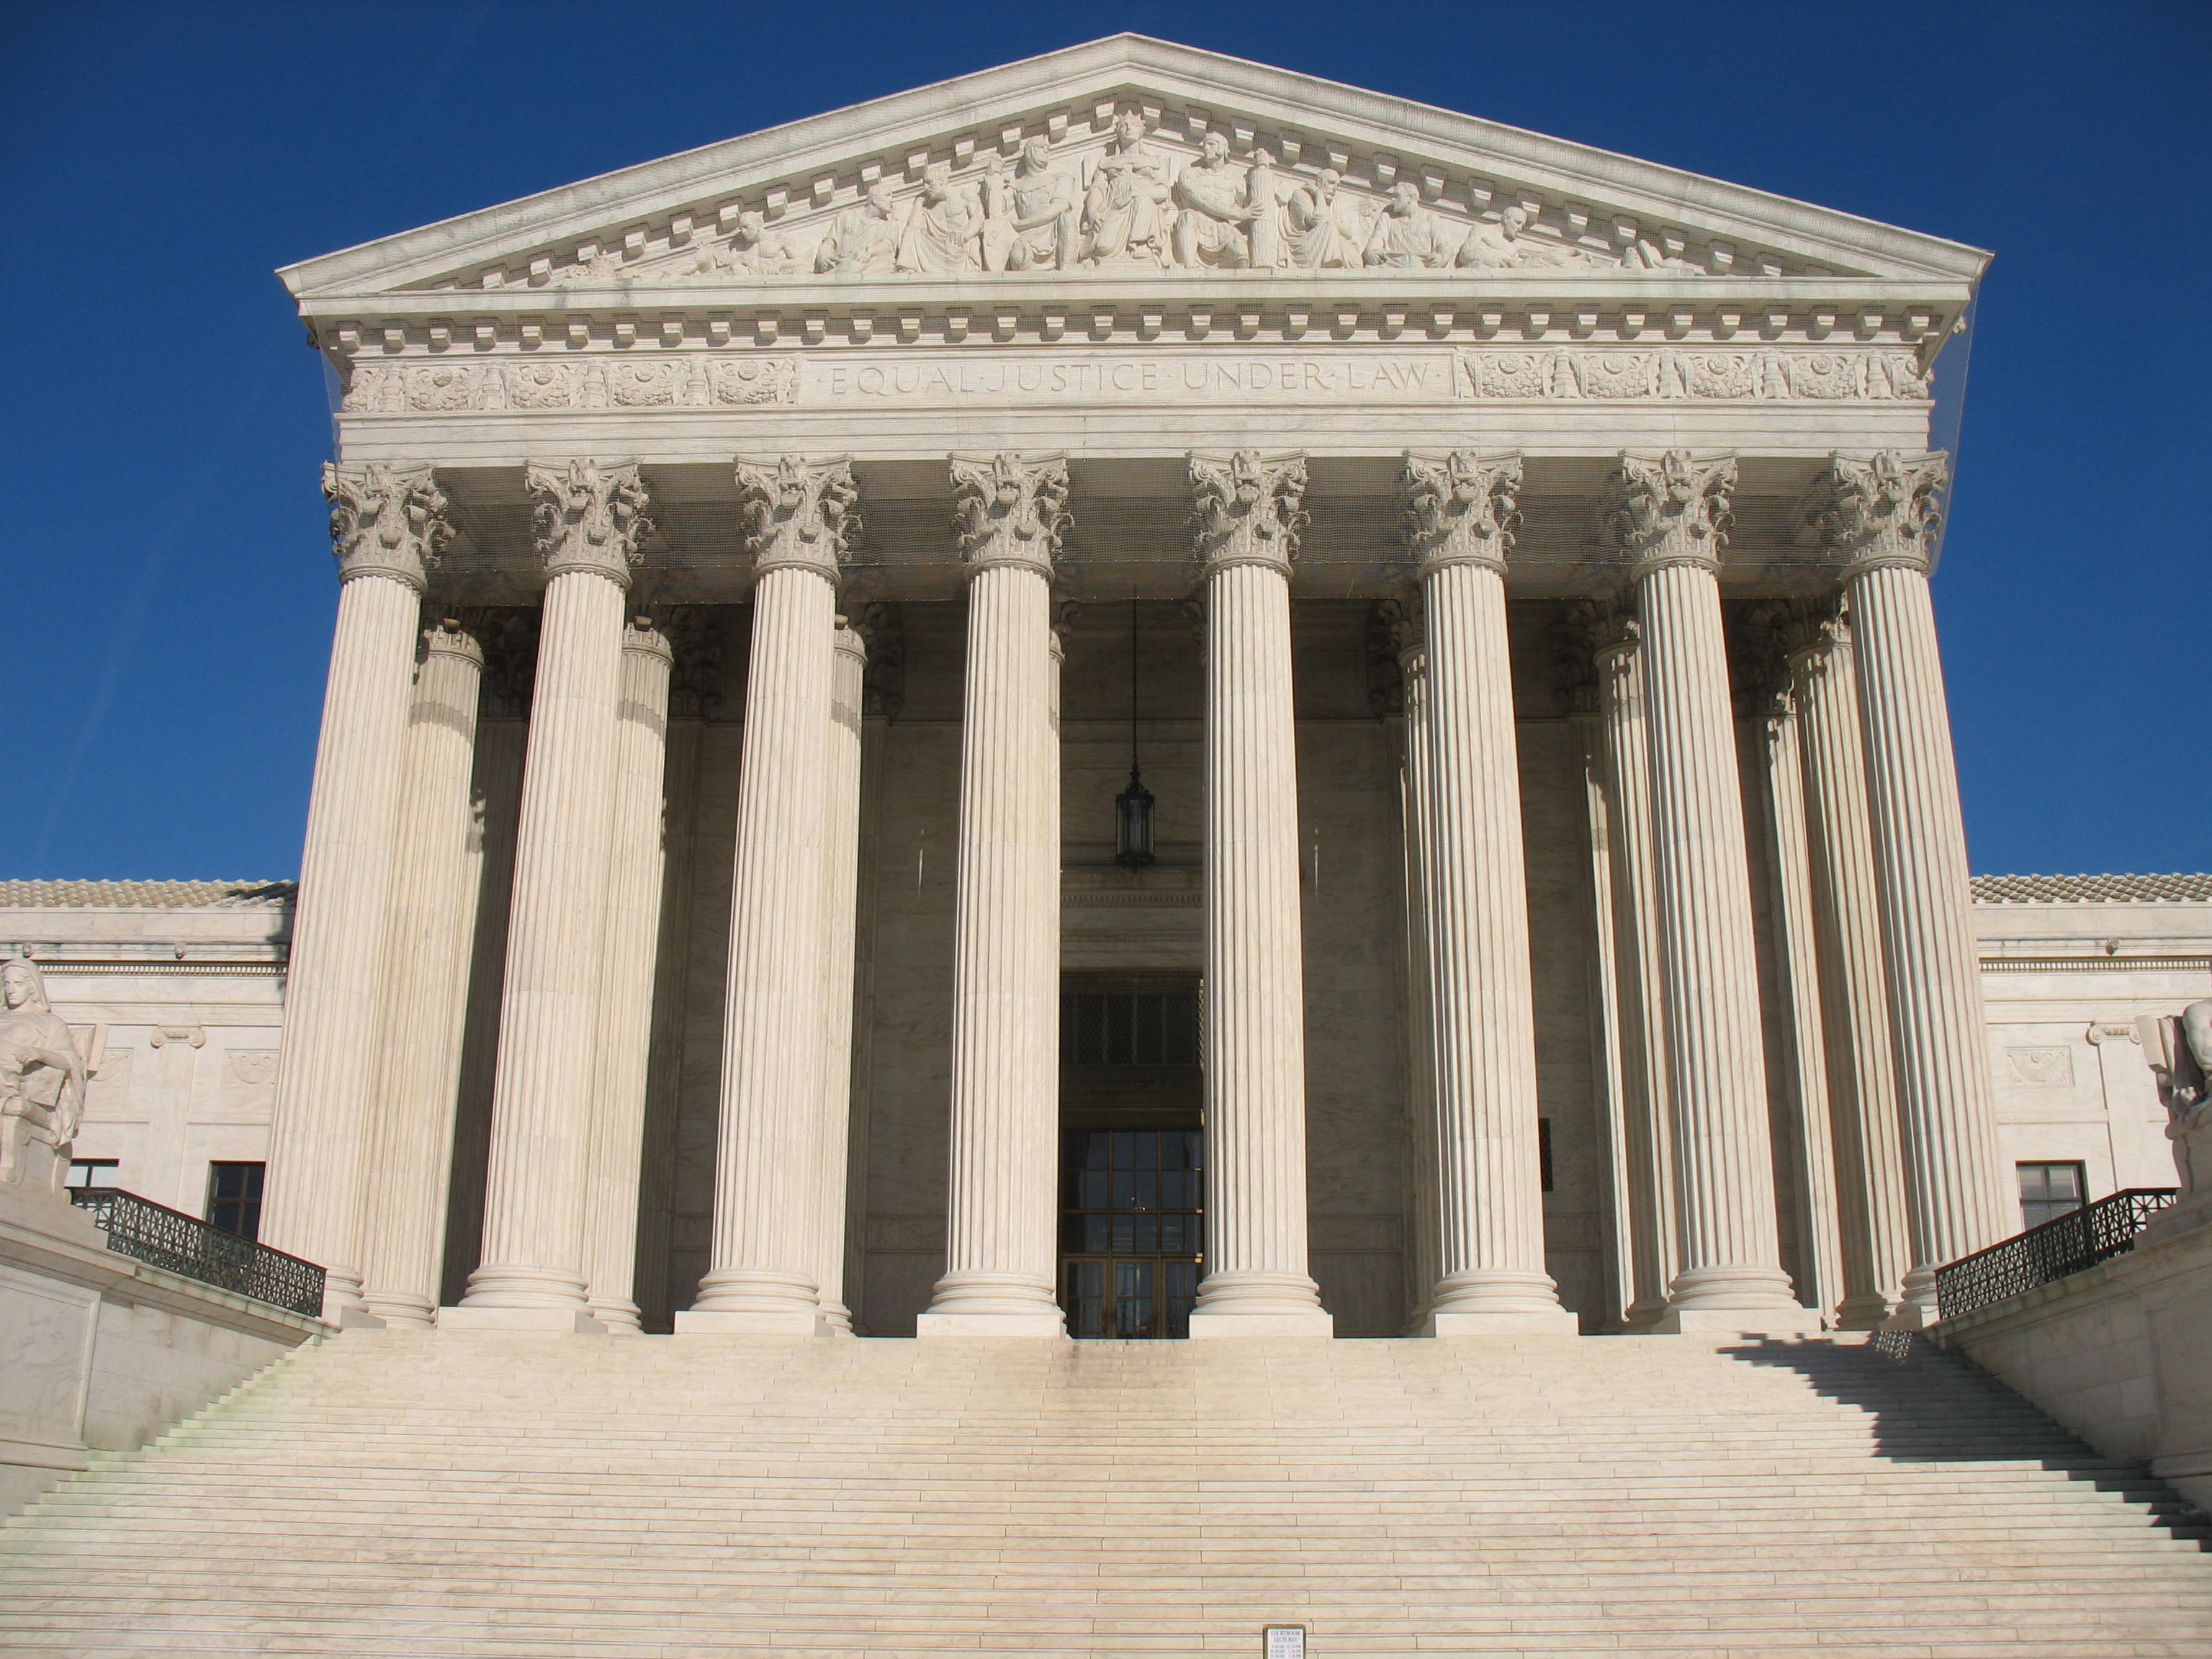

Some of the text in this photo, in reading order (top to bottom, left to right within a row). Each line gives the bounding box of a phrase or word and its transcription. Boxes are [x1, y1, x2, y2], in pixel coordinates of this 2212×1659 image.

[830, 362, 1430, 396] EQUAL JUSTICE UNDER LAW
